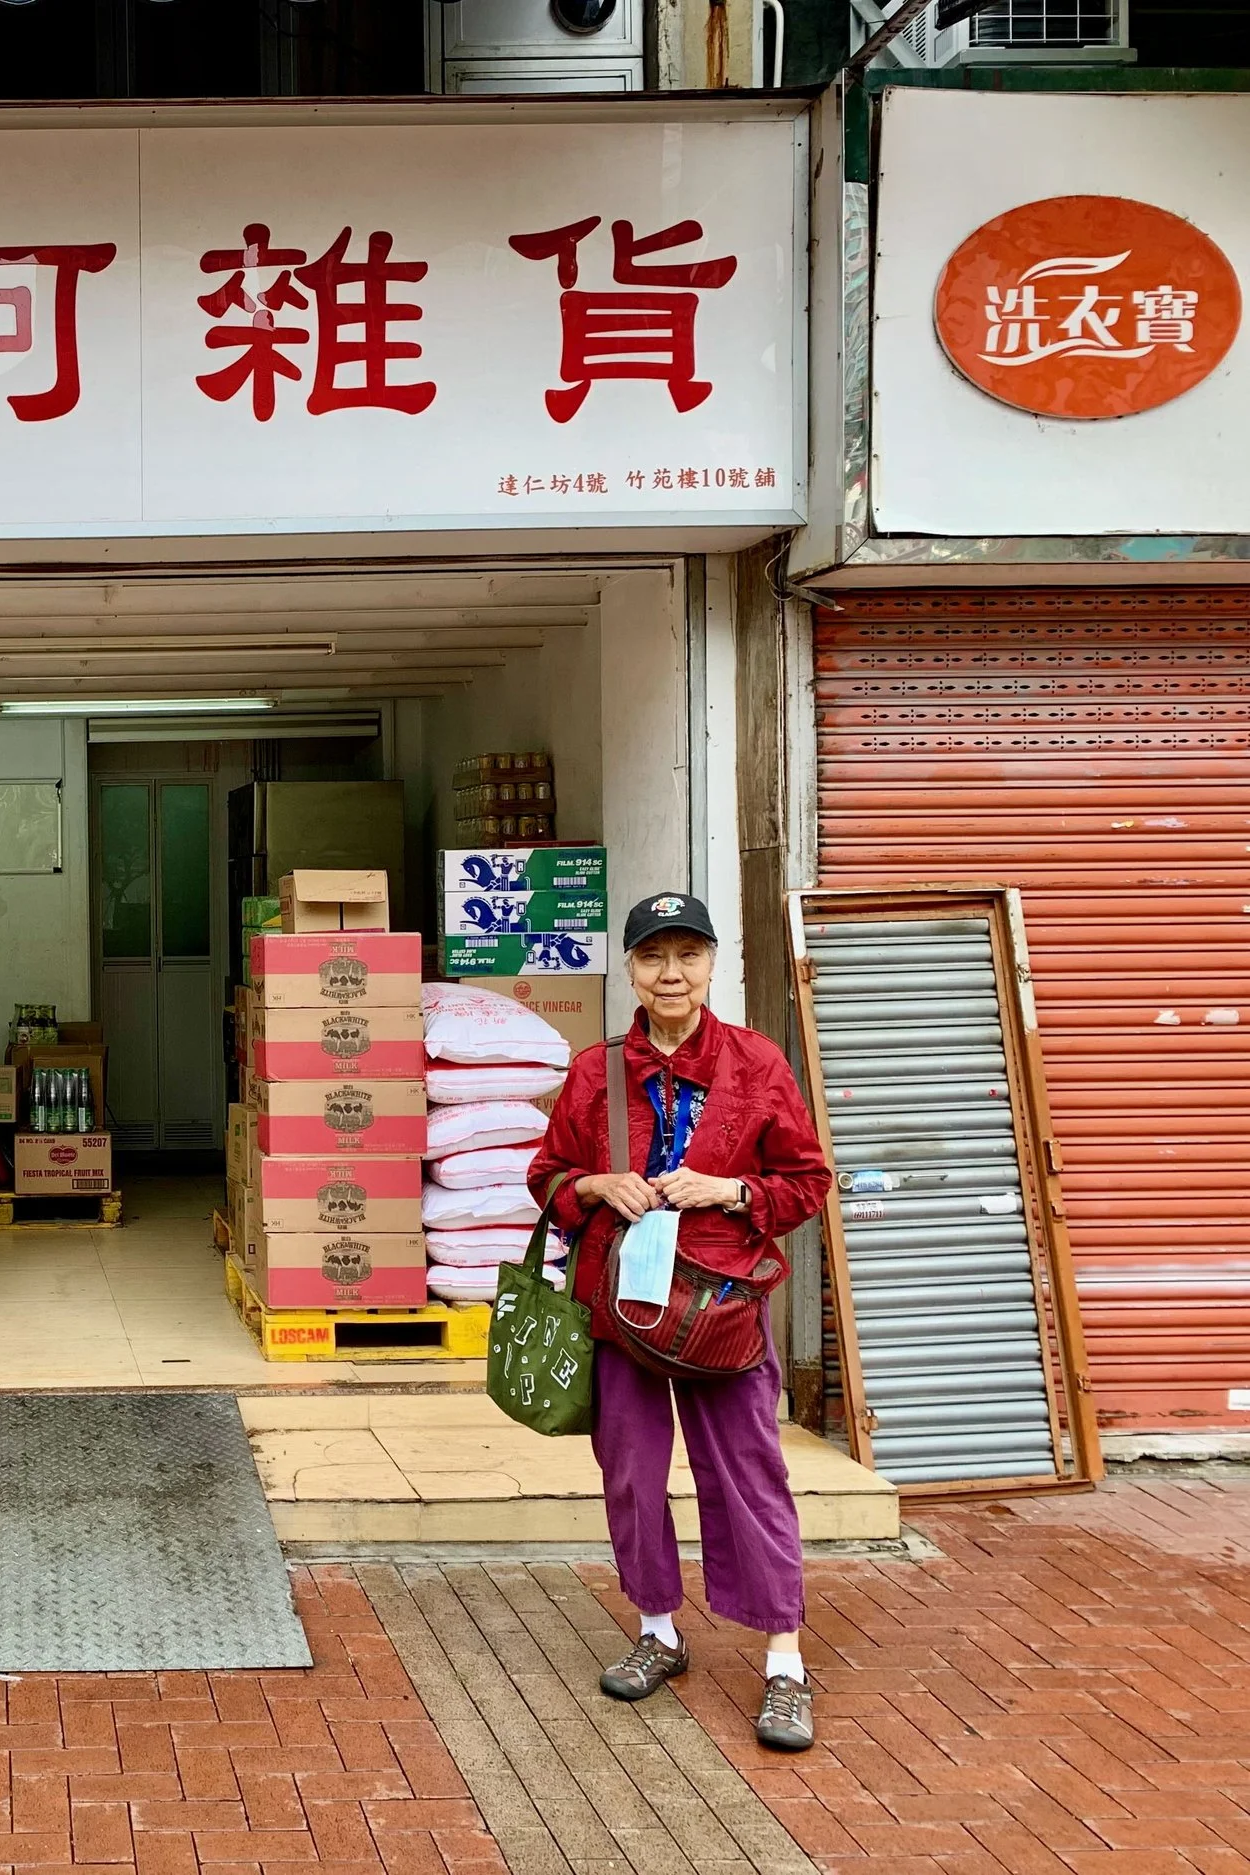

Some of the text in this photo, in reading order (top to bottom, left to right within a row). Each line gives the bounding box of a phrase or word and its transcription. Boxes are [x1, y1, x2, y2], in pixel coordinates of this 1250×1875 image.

[984, 284, 1198, 354] 洗衣寶
[497, 472, 609, 497] 達仁坊4號
[575, 858, 592, 866] 914
[576, 900, 593, 908] 914
[520, 1001, 582, 1013] ICE VINEGAR
[335, 1062, 358, 1070] MILK
[82, 1138, 107, 1147] 55207
[338, 1136, 360, 1144] MILK
[22, 1169, 104, 1178] FIESTA TROPICAL FRUIT MIX
[335, 1288, 359, 1296] MILK
[270, 1327, 330, 1345] LOSCAM
